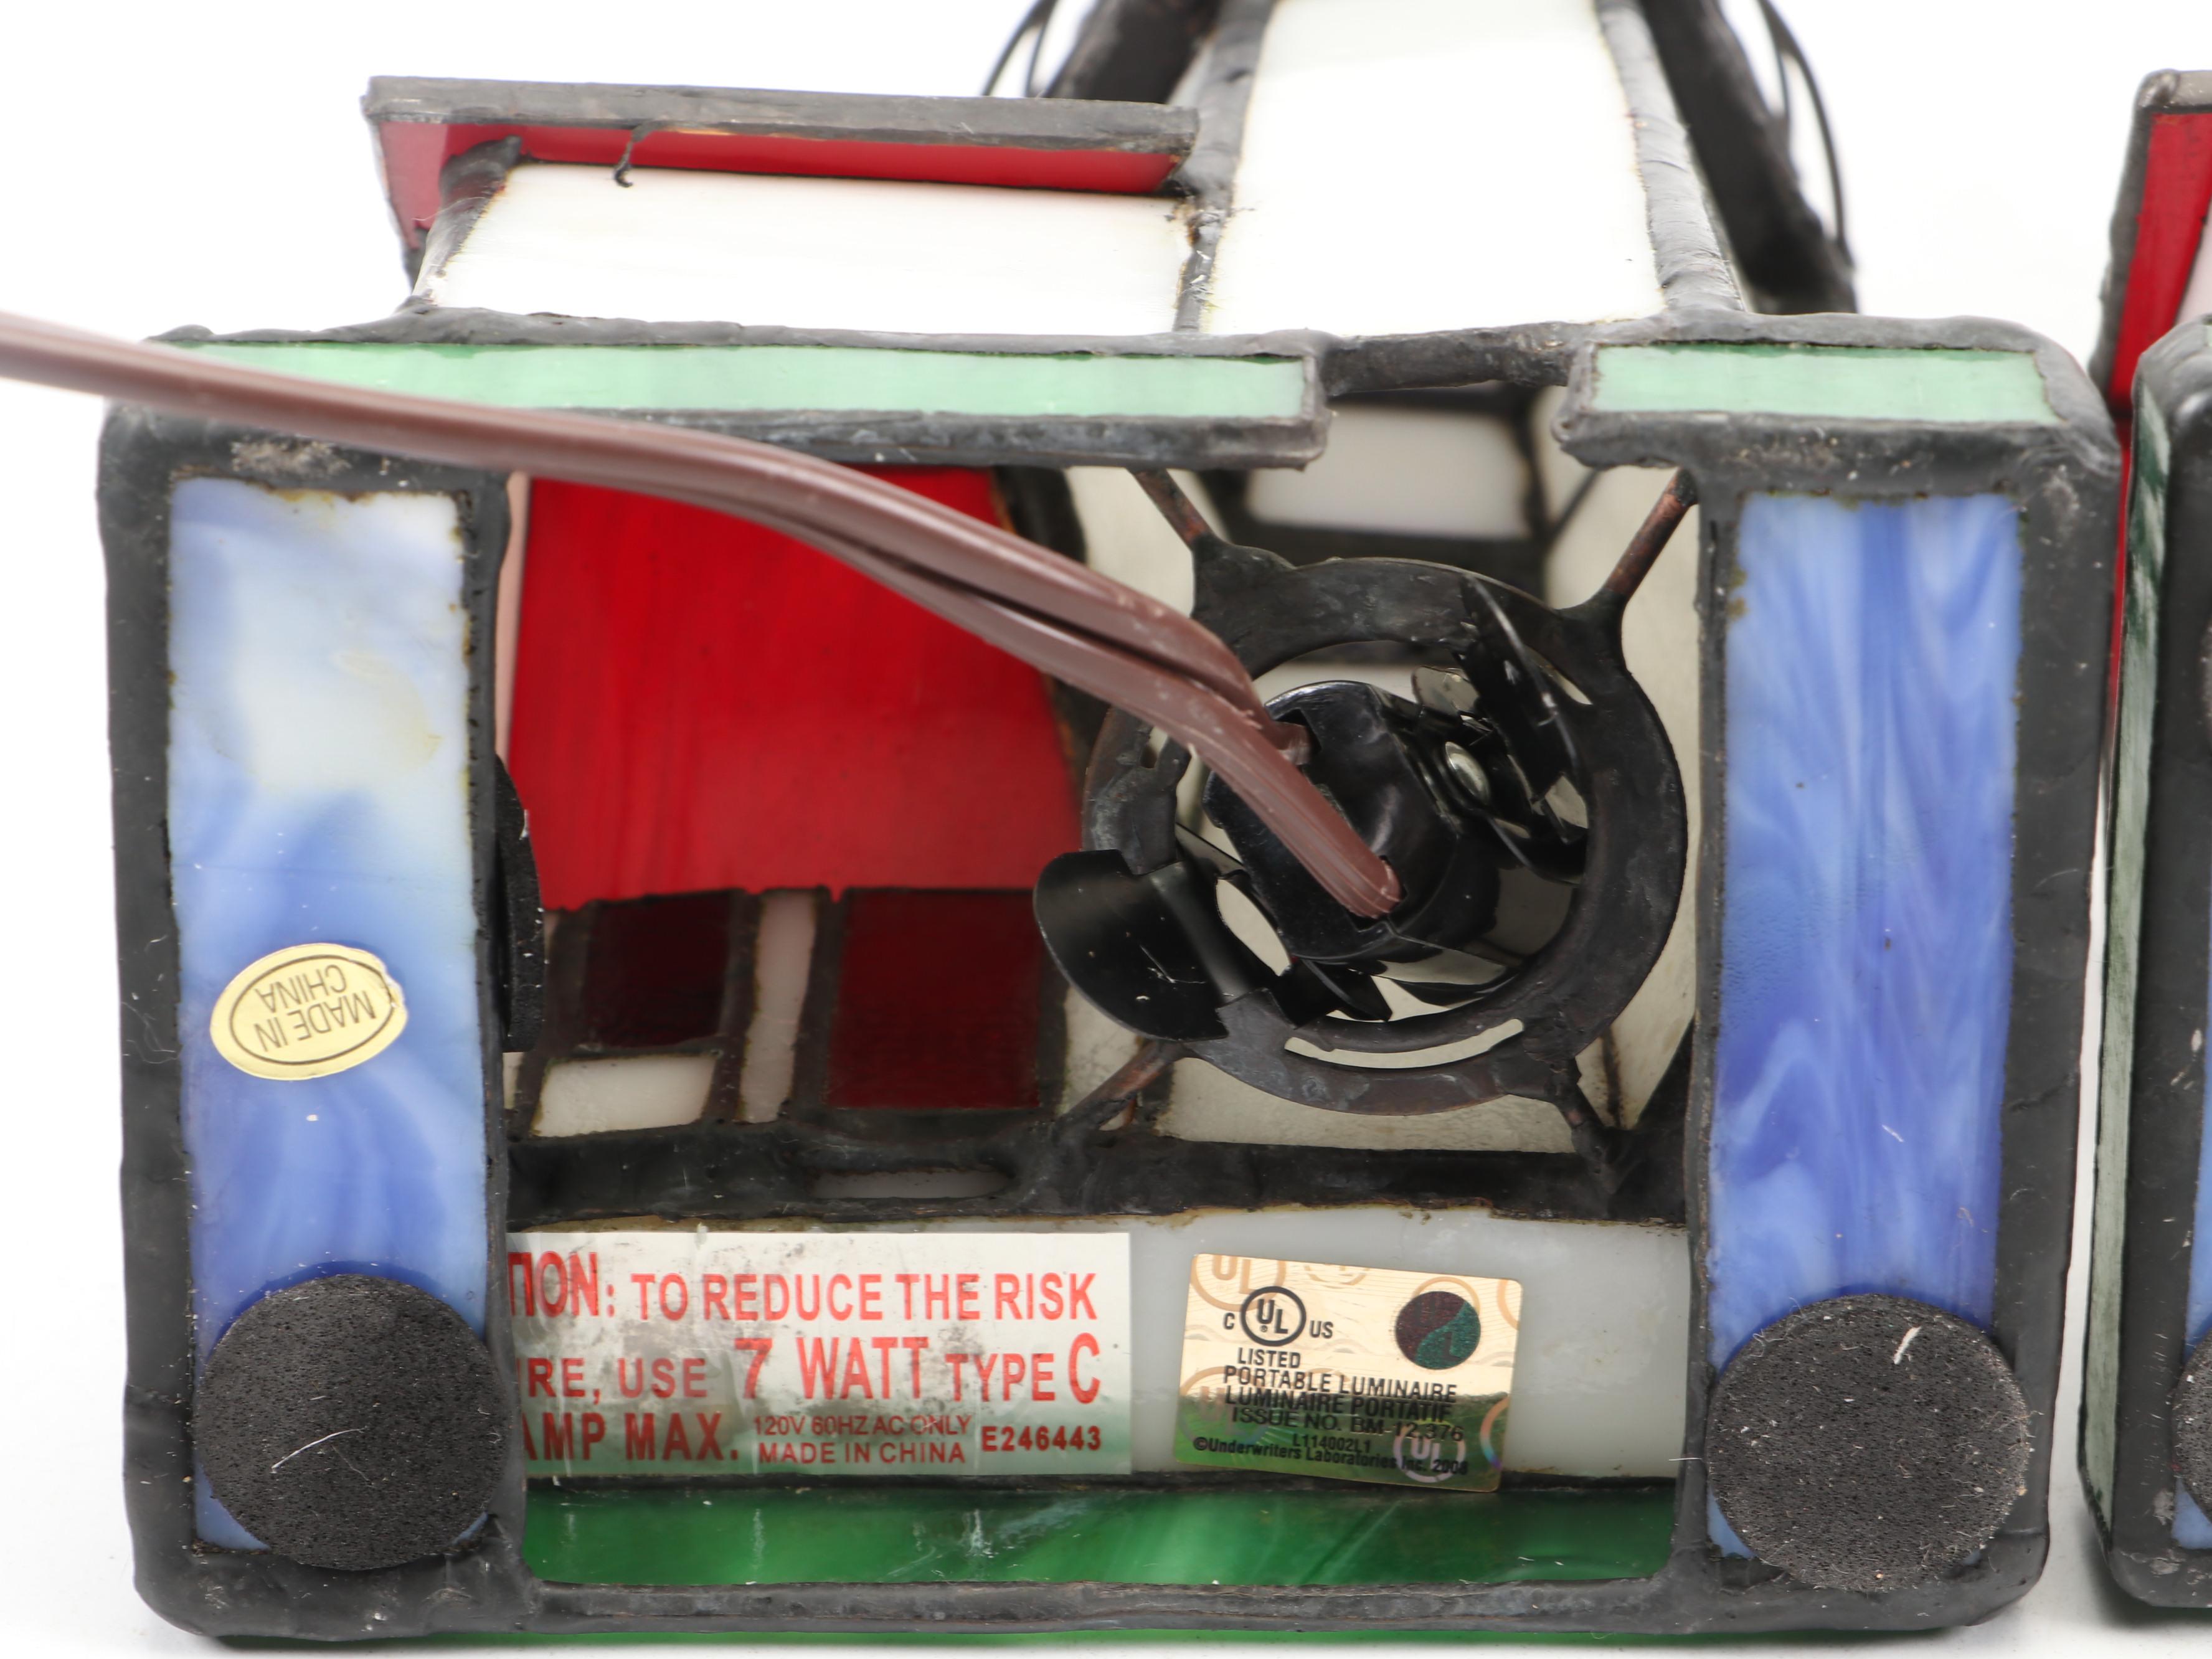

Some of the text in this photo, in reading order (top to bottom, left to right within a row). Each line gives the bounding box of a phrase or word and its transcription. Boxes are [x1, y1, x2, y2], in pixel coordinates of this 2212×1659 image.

[255, 965, 347, 1014] CHINA
[253, 990, 376, 1052] MADE IN
[631, 1273, 688, 1321] TO
[702, 1273, 883, 1321] REDUCE
[895, 1273, 981, 1321] THE
[995, 1272, 1098, 1321] RISK
[1310, 1320, 1334, 1339] US
[617, 1358, 707, 1399] USE
[734, 1337, 773, 1399] 7
[796, 1336, 929, 1400] WATT
[945, 1353, 1056, 1402] TYPE
[1068, 1332, 1102, 1404] C
[1237, 1347, 1301, 1369] LISTED
[1223, 1364, 1458, 1404] PORTABLE LUMINAIRE
[1224, 1384, 1452, 1423] LUMINAIRE PORTATIF
[1232, 1406, 1298, 1429] ISSUE
[1305, 1412, 1342, 1432] NO.
[625, 1412, 739, 1461] MAX.
[754, 1414, 973, 1437] 120V 60HZ AC ONLY
[981, 1426, 1102, 1452] E246443
[759, 1442, 966, 1464] MADE IN CHINA
[1305, 1447, 1397, 1470] Laboratories
